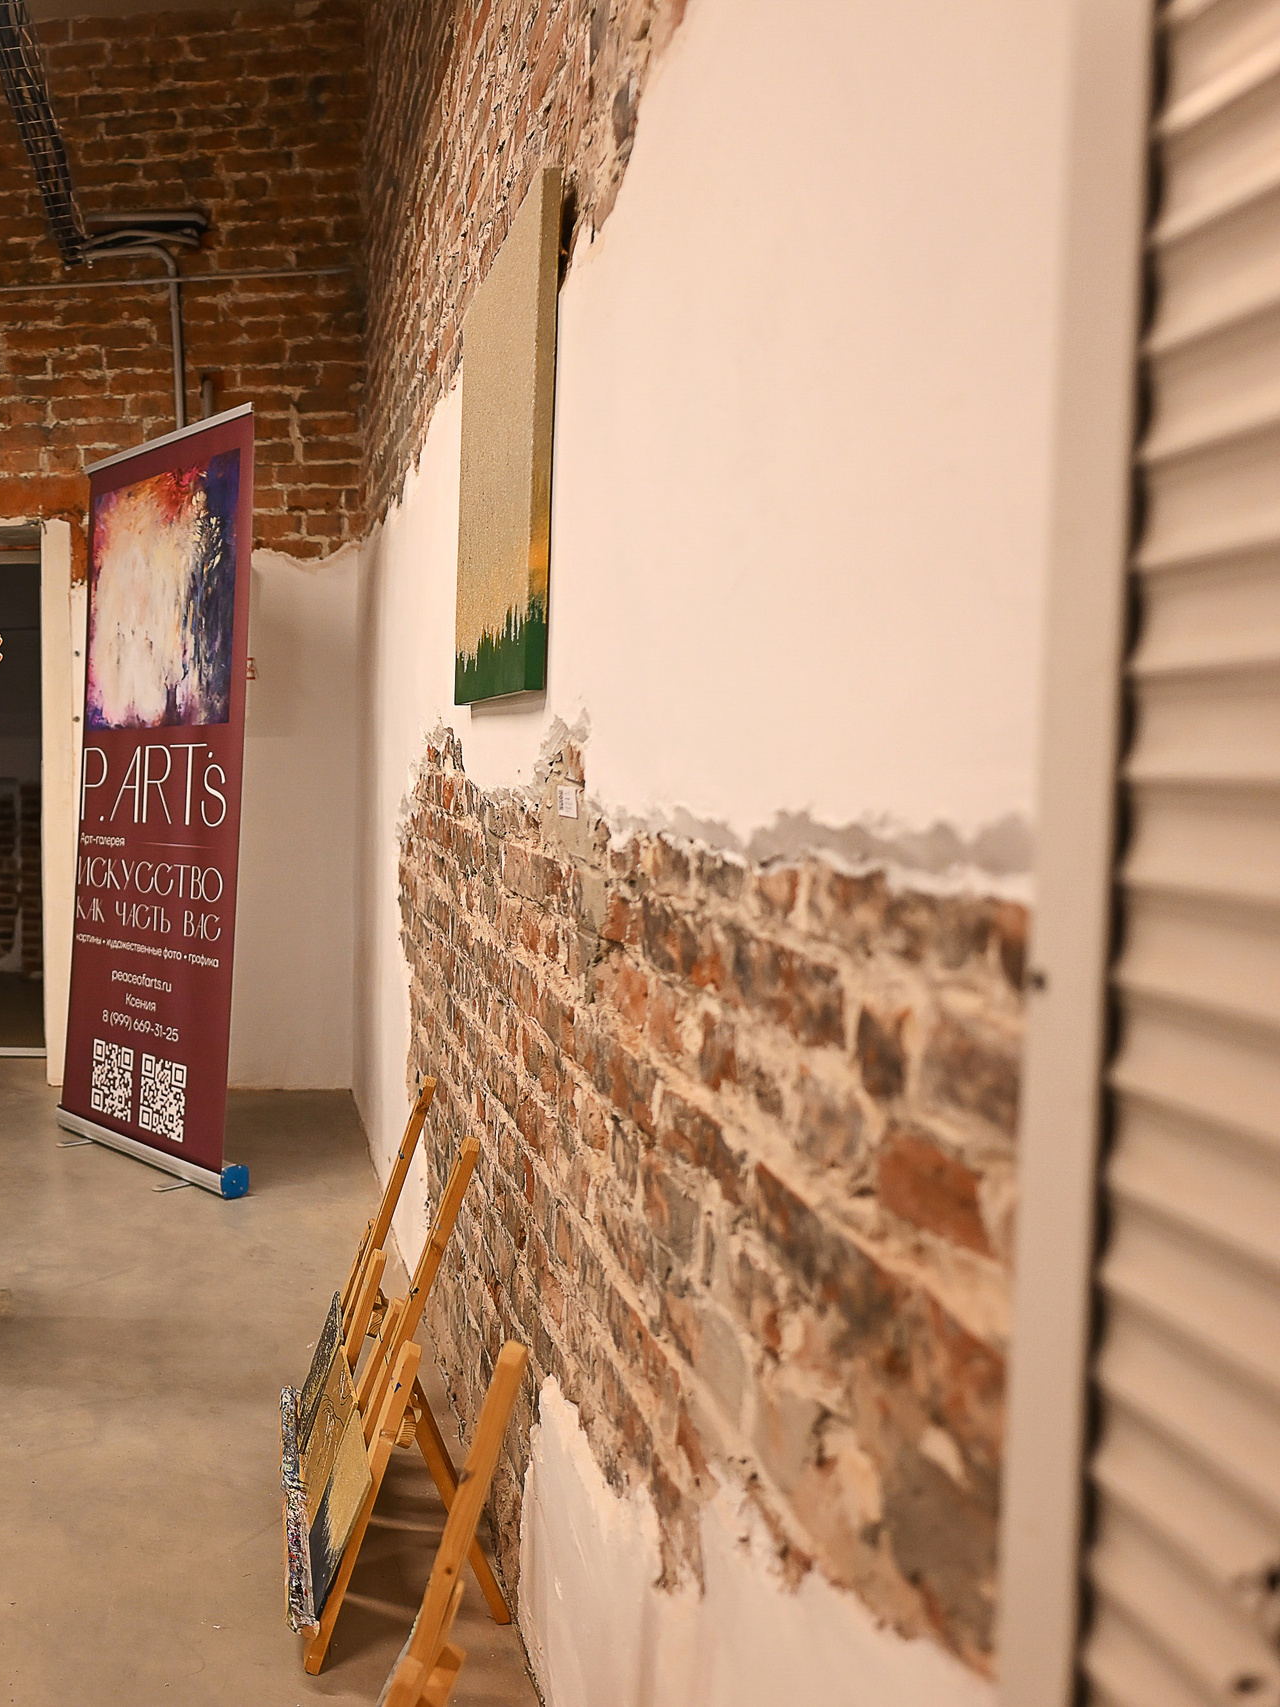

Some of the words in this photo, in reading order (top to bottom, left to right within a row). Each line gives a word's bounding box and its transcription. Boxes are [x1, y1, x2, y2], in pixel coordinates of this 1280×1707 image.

[80, 832, 125, 848] Арт-галерея
[77, 856, 223, 903] ИСКУССТВО
[75, 896, 105, 923] КАК
[115, 900, 171, 933] ЧАСТЬ
[183, 910, 221, 942] ВАС
[105, 938, 162, 956] художественные
[163, 947, 182, 960] фото
[188, 953, 219, 968] графика
[111, 970, 172, 992] peaceofarts.ru
[125, 992, 156, 1012] Ксения
[102, 1009, 109, 1022] 8
[110, 1011, 132, 1031] (999)
[133, 1018, 179, 1042] 669-31-25
